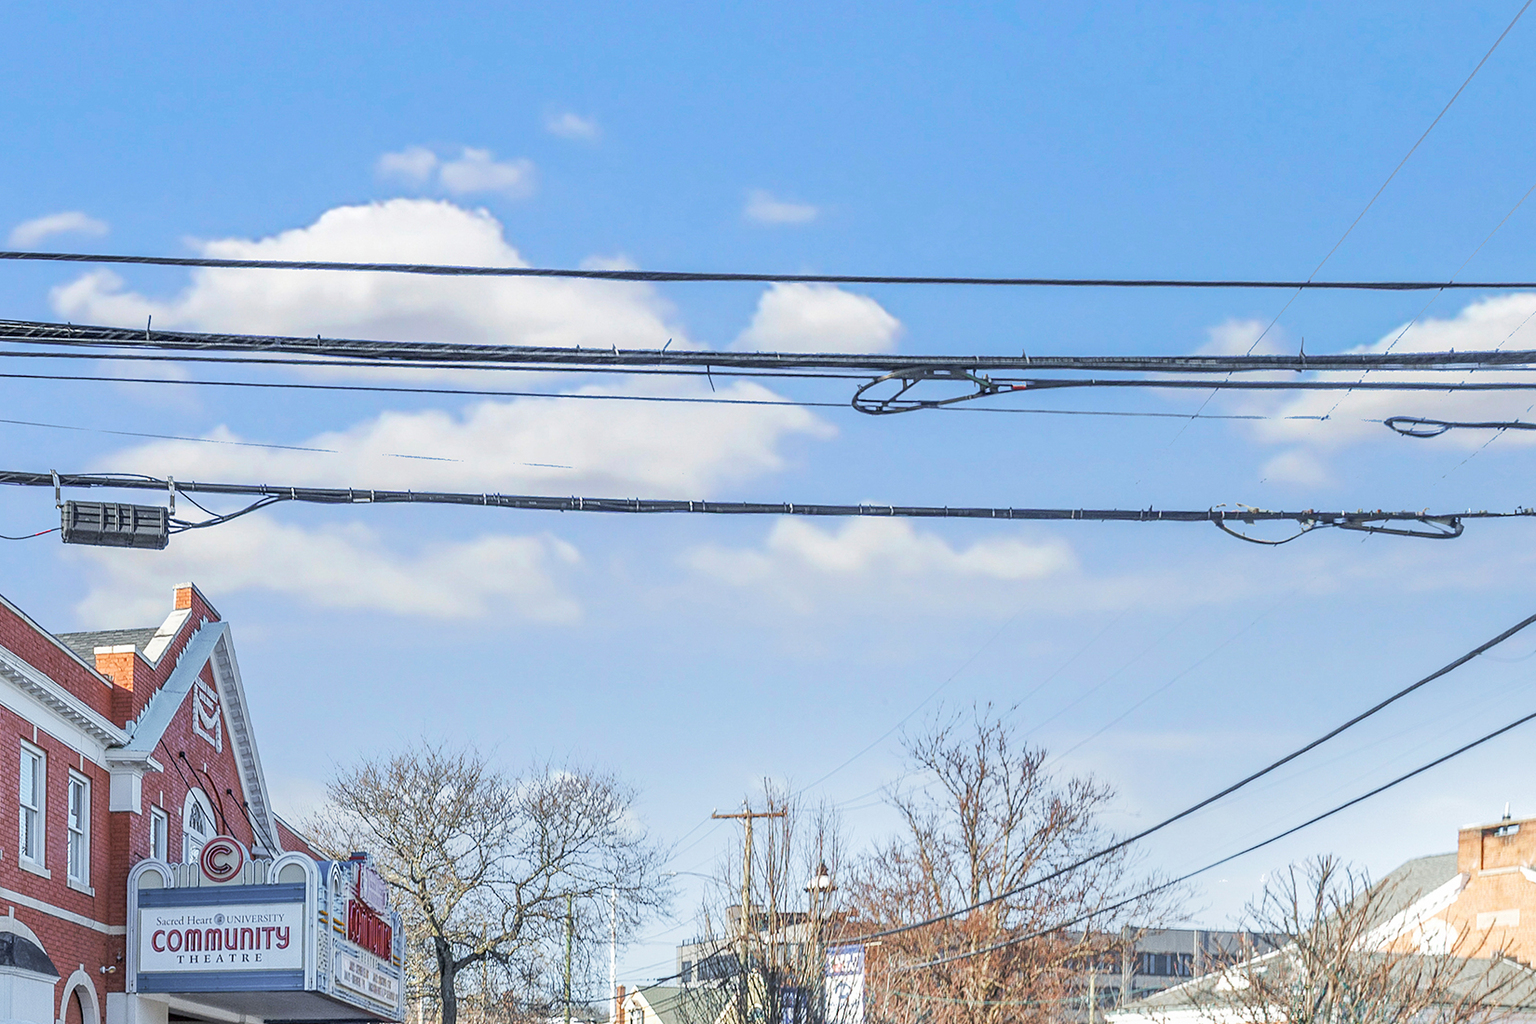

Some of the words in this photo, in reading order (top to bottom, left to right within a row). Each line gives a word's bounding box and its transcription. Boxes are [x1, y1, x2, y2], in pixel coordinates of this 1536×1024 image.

[156, 915, 184, 926] Sacred
[187, 915, 212, 925] Heart
[226, 913, 285, 924] UNIVERSITY
[151, 926, 290, 952] COMMUNITY
[177, 953, 263, 964] THEATRE
